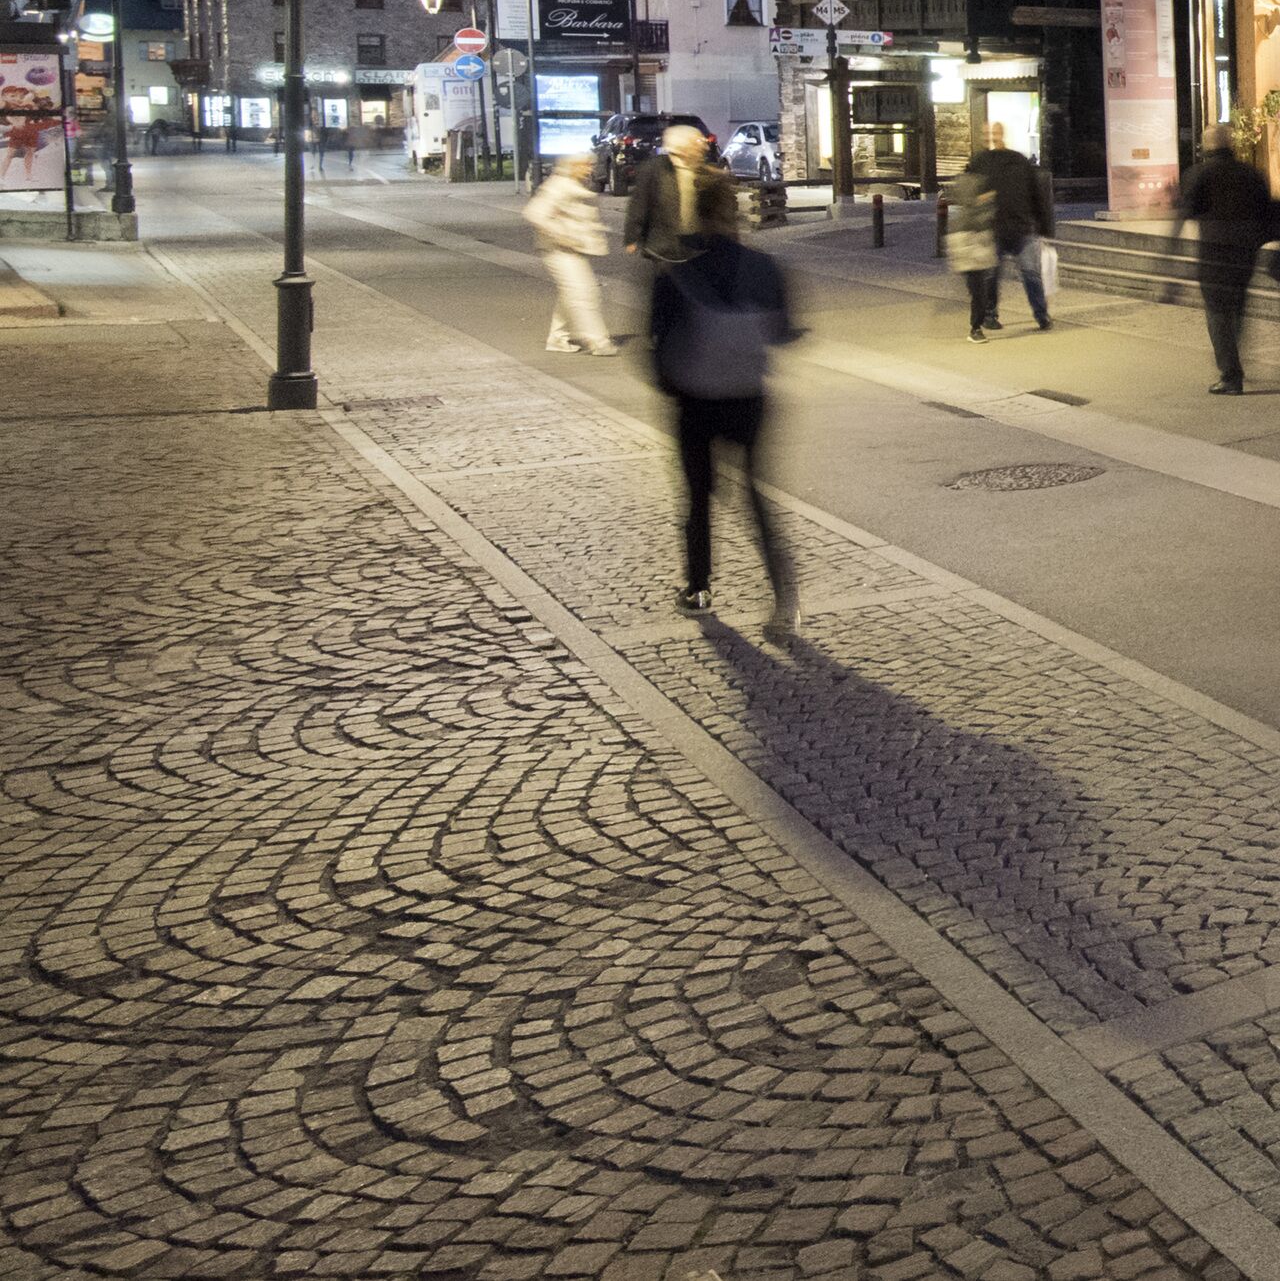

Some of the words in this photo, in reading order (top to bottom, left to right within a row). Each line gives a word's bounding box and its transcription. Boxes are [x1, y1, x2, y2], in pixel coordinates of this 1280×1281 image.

[816, 7, 828, 15] M4
[833, 7, 846, 15] M5
[545, 8, 624, 29] Barbara
